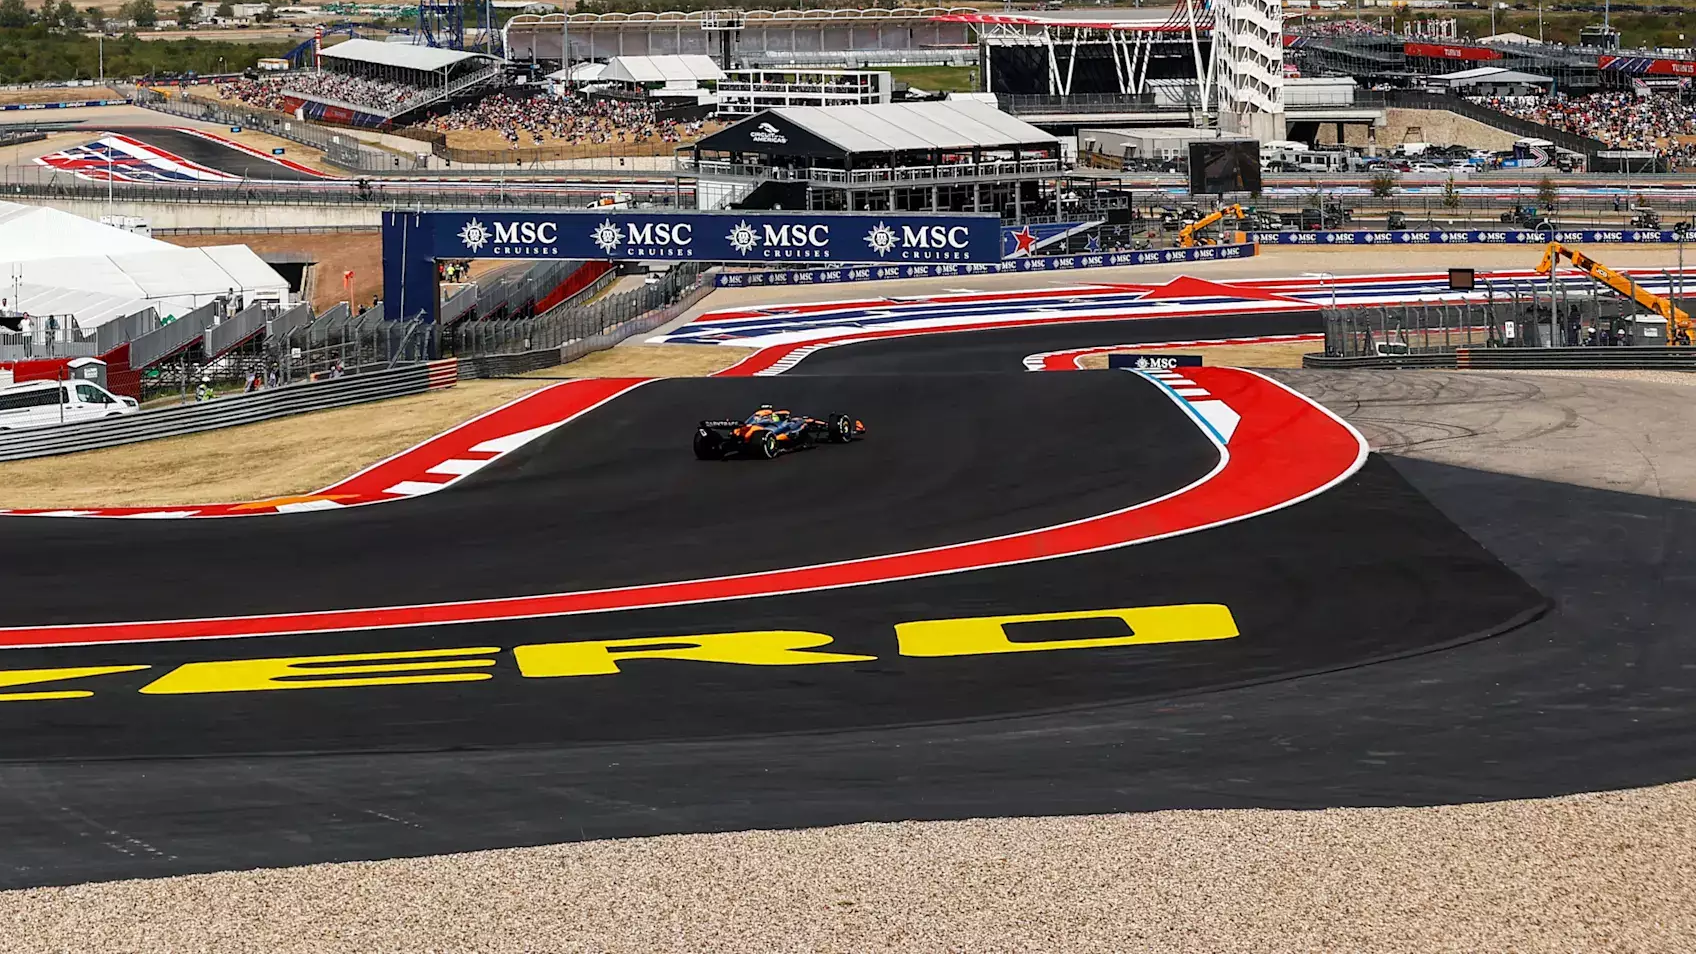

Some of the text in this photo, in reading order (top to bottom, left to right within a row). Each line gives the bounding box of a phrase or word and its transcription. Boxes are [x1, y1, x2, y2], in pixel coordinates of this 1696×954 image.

[493, 222, 558, 244] MSC
[627, 223, 692, 245] MSC
[763, 224, 829, 247] MSC
[902, 225, 969, 248] MSC
[1374, 233, 1392, 241] MSC
[627, 248, 692, 256] CRUISES
[902, 251, 969, 259] CRUISES
[728, 275, 742, 283] MSC
[774, 273, 787, 282] MSC
[799, 273, 813, 281] MSC
[826, 271, 841, 280] MSC
[855, 269, 870, 278] MSC
[884, 268, 899, 276] MSC
[913, 266, 928, 275] MSC
[942, 265, 957, 273] MSC
[972, 263, 987, 272] MSC
[1002, 261, 1016, 270] MSC
[1031, 259, 1045, 268] MSC
[1059, 258, 1074, 266] MSC
[1088, 256, 1103, 265] MSC
[1117, 255, 1131, 263] MSC
[1145, 253, 1159, 261] MSC
[1172, 251, 1186, 259] MSC
[1199, 249, 1213, 258] MSC
[1227, 247, 1240, 256] MSC
[1150, 358, 1177, 368] MSC
